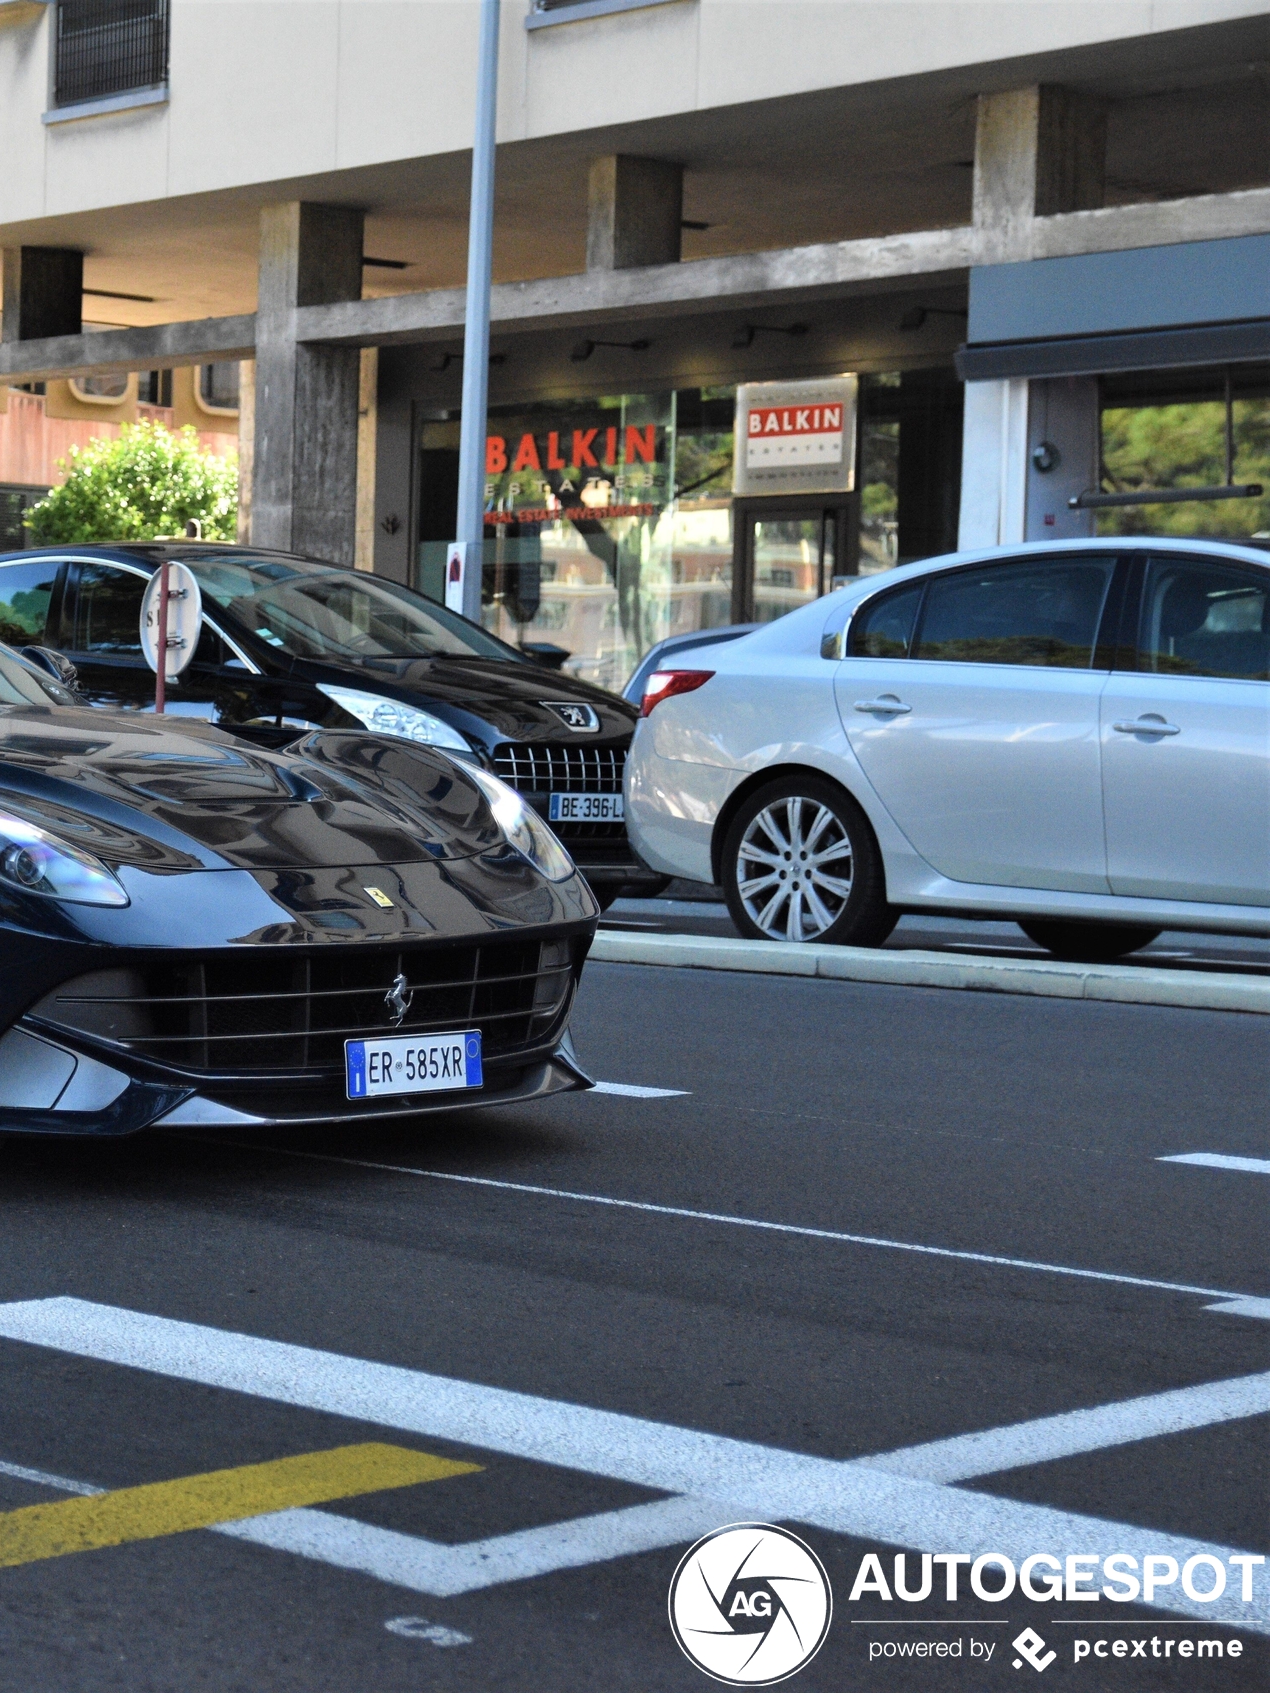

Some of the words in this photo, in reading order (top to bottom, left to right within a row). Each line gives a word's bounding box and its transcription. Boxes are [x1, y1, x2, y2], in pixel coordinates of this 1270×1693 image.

[749, 408, 841, 433] BALKIN
[485, 424, 656, 474] BALKIN
[485, 474, 655, 497] ESTATES
[484, 511, 513, 524] REAL
[518, 509, 561, 523] ESTATE
[565, 503, 653, 521] INVESTMENTS
[561, 797, 625, 818] BE-396-L
[369, 1051, 393, 1084] ER
[405, 1045, 464, 1081] 585XR
